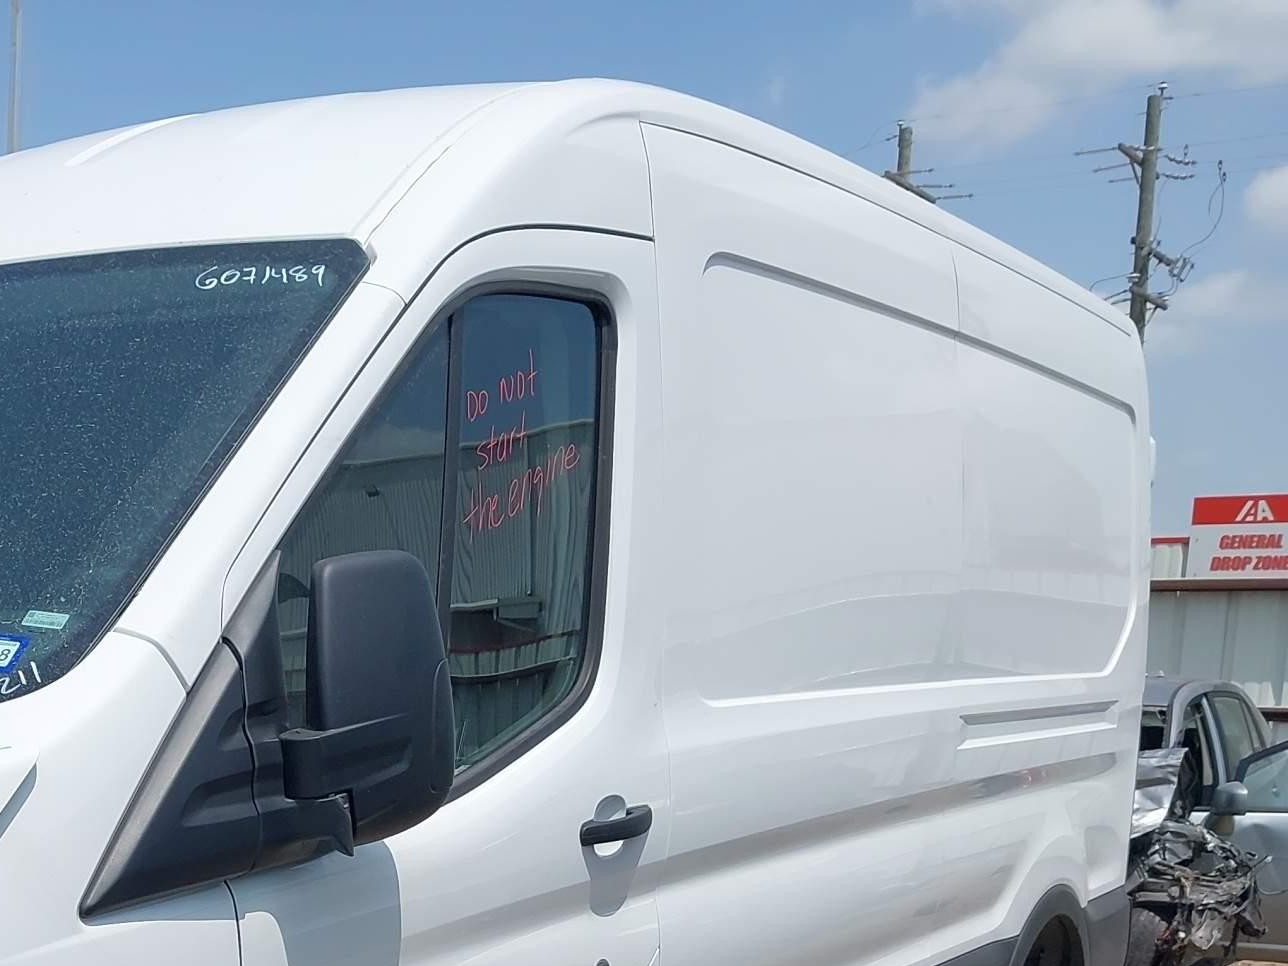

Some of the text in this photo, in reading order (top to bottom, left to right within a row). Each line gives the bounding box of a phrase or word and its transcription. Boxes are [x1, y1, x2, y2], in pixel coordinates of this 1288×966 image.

[195, 265, 325, 290] 6071489
[477, 410, 527, 471] start
[463, 443, 580, 545] the engine
[1219, 534, 1283, 549] GENERAL
[1210, 556, 1252, 571] DROP
